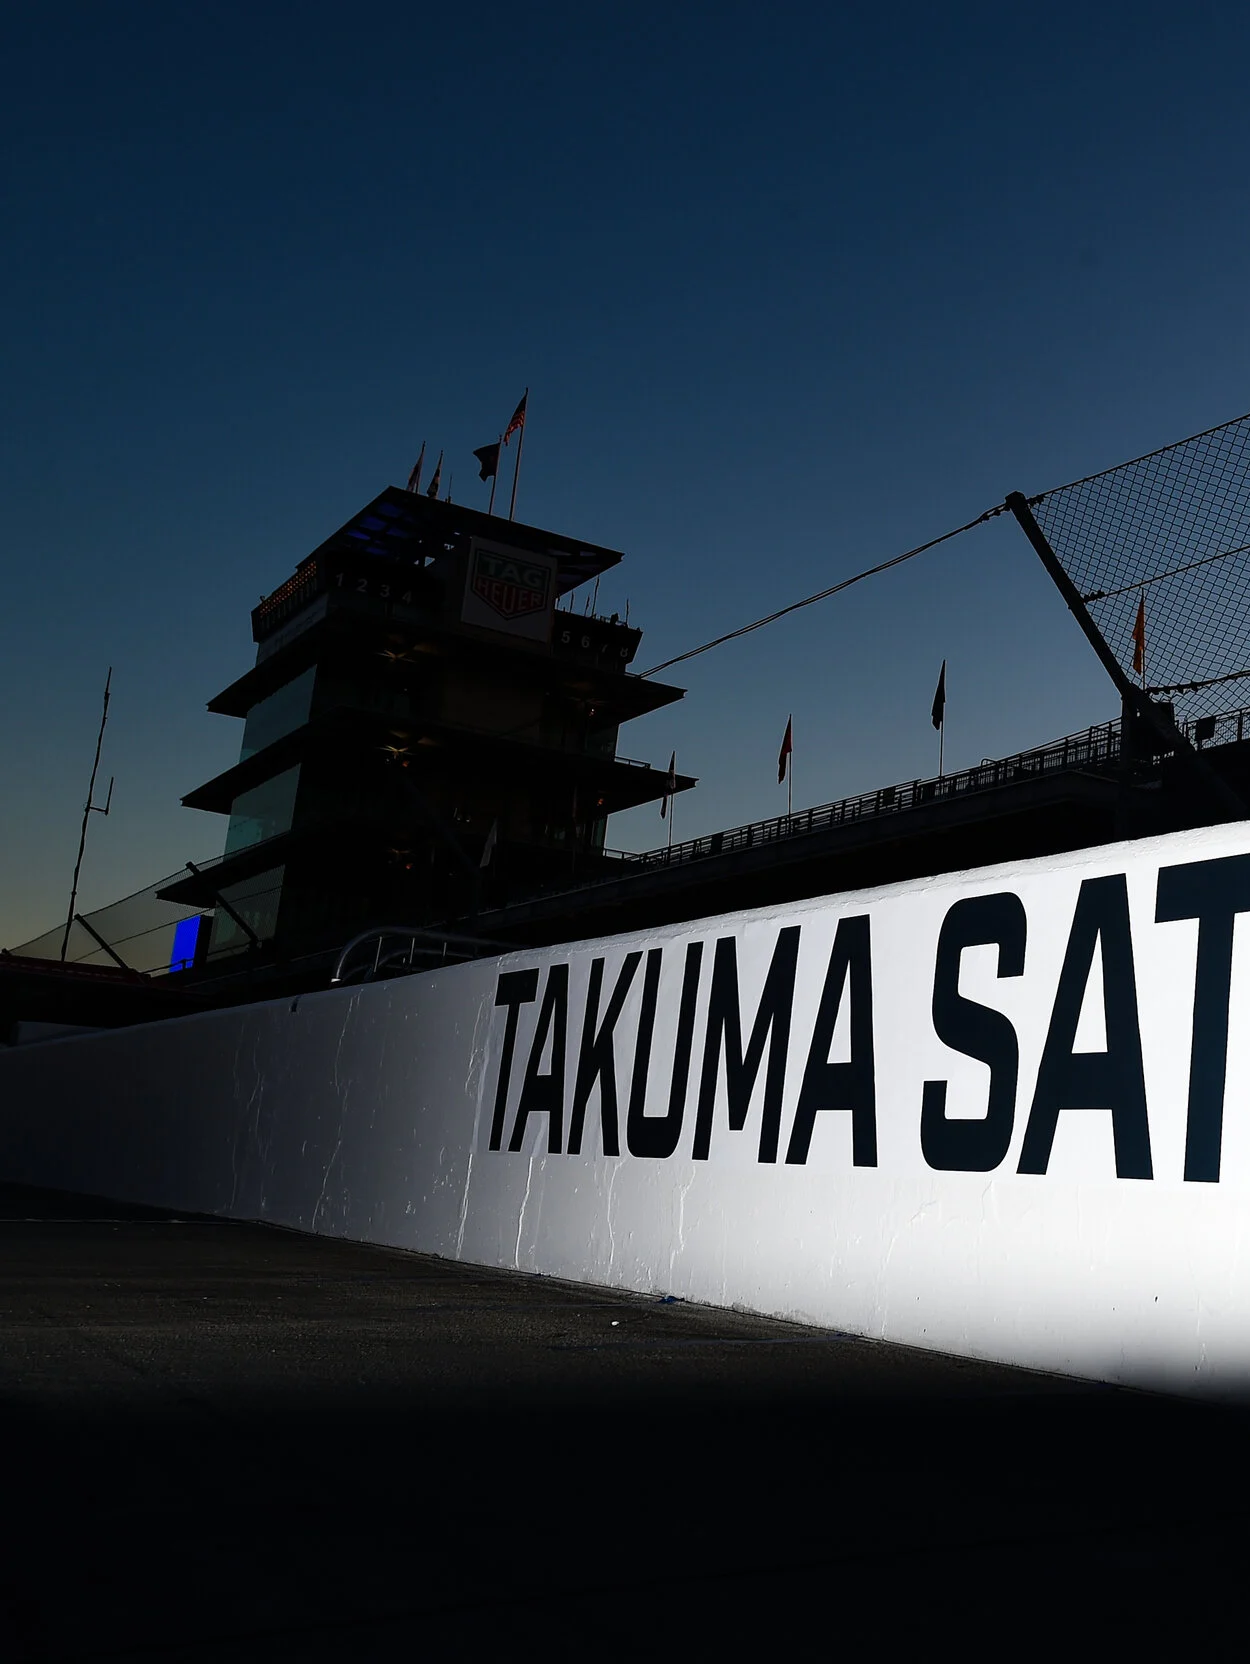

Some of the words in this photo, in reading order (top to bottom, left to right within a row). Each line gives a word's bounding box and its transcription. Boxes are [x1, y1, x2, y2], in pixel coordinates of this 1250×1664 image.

[335, 571, 345, 588] 1
[356, 577, 369, 593] 2
[379, 583, 393, 600] 3
[401, 590, 413, 605] 4
[480, 556, 542, 588] TAG
[476, 576, 543, 611] HEUER
[560, 630, 572, 645] 5
[580, 634, 591, 649] 6
[619, 646, 629, 658] 8
[489, 914, 878, 1168] TAKUMA
